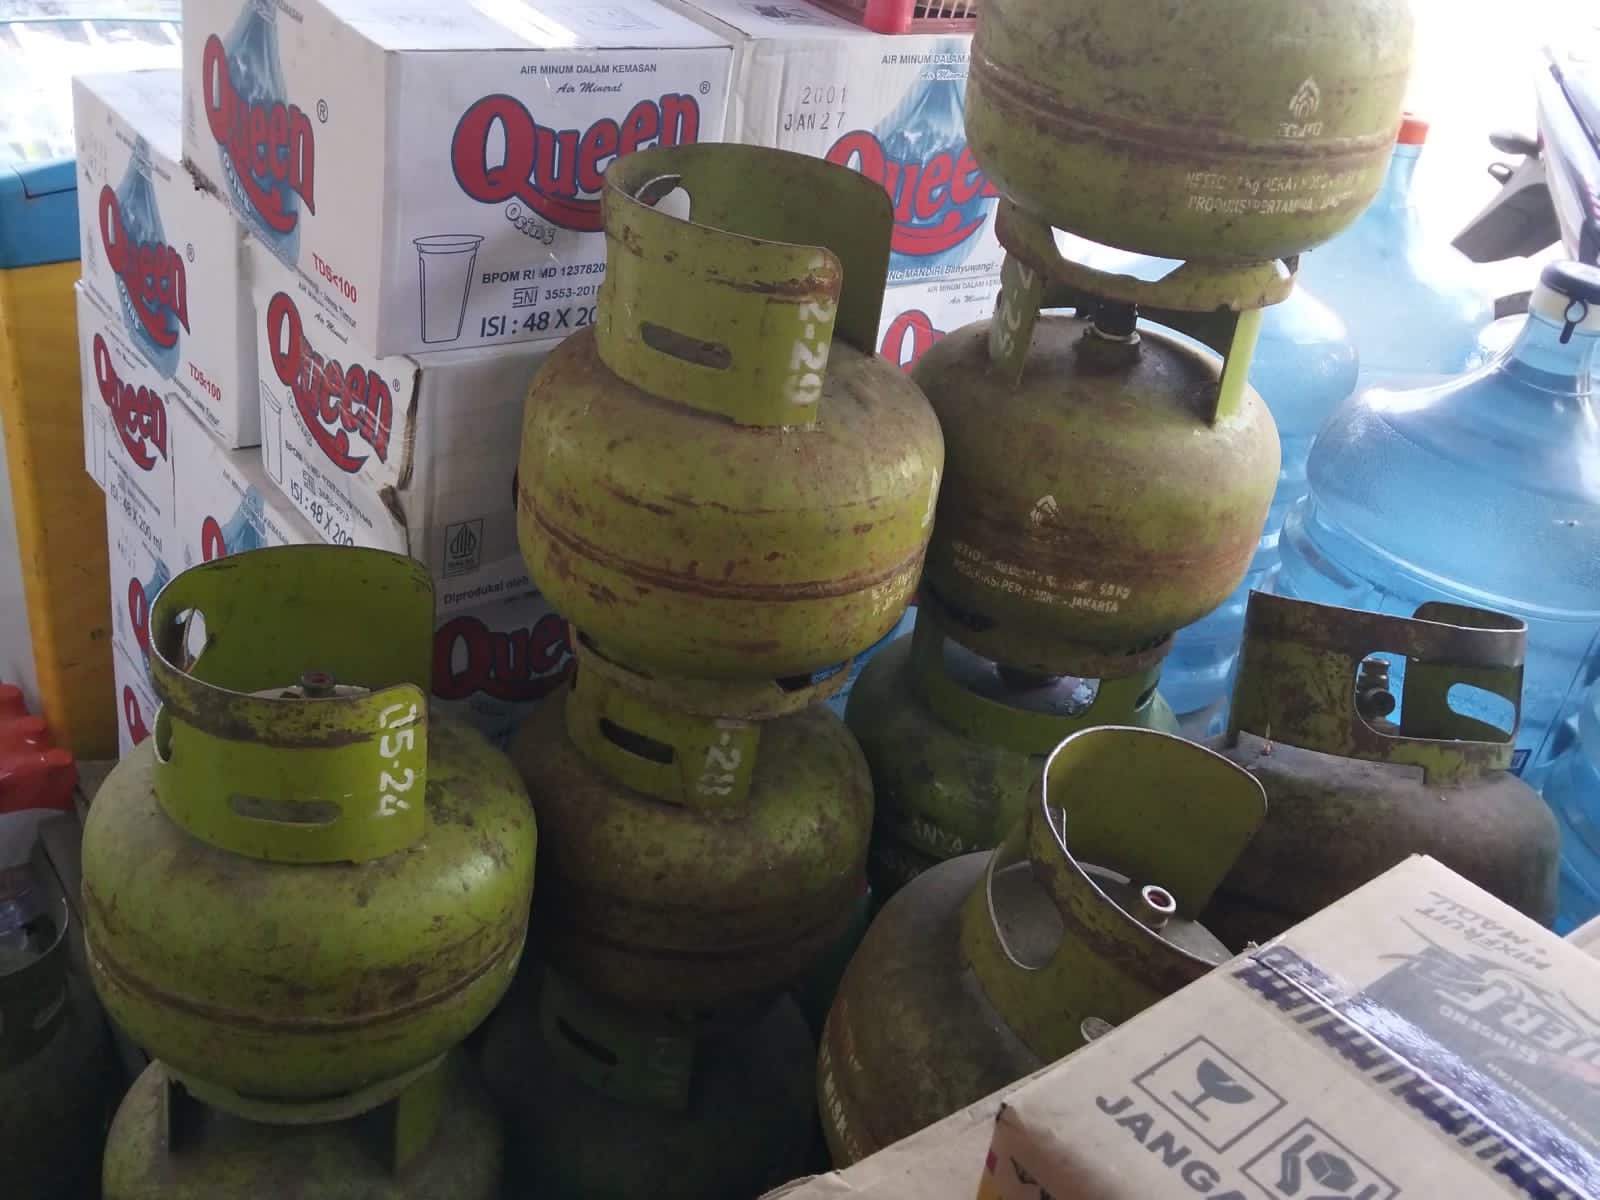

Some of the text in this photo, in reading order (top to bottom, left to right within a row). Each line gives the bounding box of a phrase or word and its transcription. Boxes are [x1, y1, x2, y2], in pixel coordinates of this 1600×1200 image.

[520, 63, 657, 75] AIR MINUM DALAM KEMASAN
[881, 55, 898, 65] AIR
[899, 55, 931, 65] MINUM
[556, 81, 623, 94] Air Mineral
[202, 33, 316, 233] Queen
[784, 113, 815, 132] JAN
[451, 93, 700, 232] Queen
[825, 130, 1001, 256] Quee
[99, 184, 190, 347] Queen
[312, 252, 357, 303] TDS<100
[482, 269, 520, 284] BPOM
[480, 315, 506, 338] ISI
[523, 312, 550, 332] 48
[554, 308, 571, 329] X
[93, 333, 167, 471] Queen
[266, 291, 393, 474] Queen
[310, 501, 323, 524] 48
[324, 512, 333, 535] X
